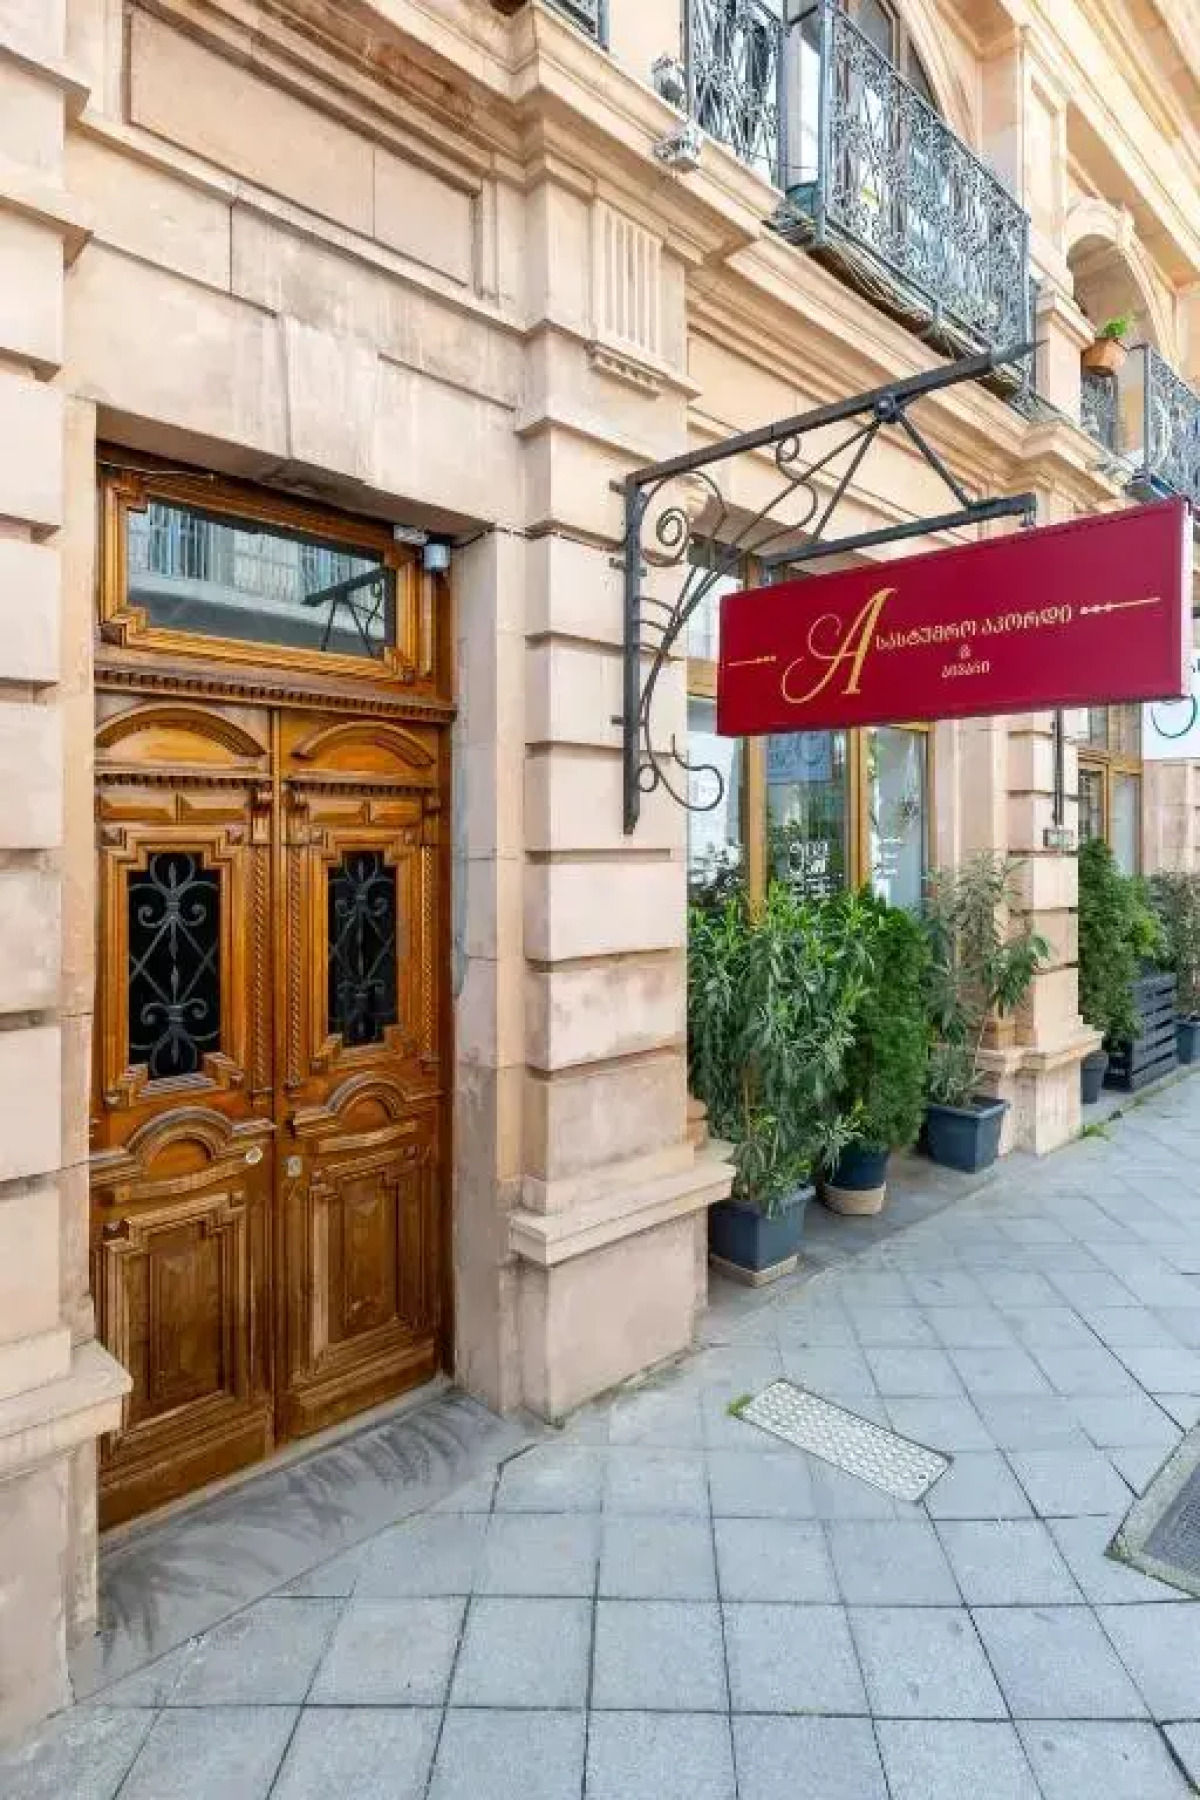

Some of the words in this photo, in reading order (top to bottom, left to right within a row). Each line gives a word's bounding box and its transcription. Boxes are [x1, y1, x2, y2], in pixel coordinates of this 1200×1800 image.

[781, 588, 898, 703] A
[875, 620, 976, 650] სასტუმრო
[981, 605, 1072, 635] აკორდი
